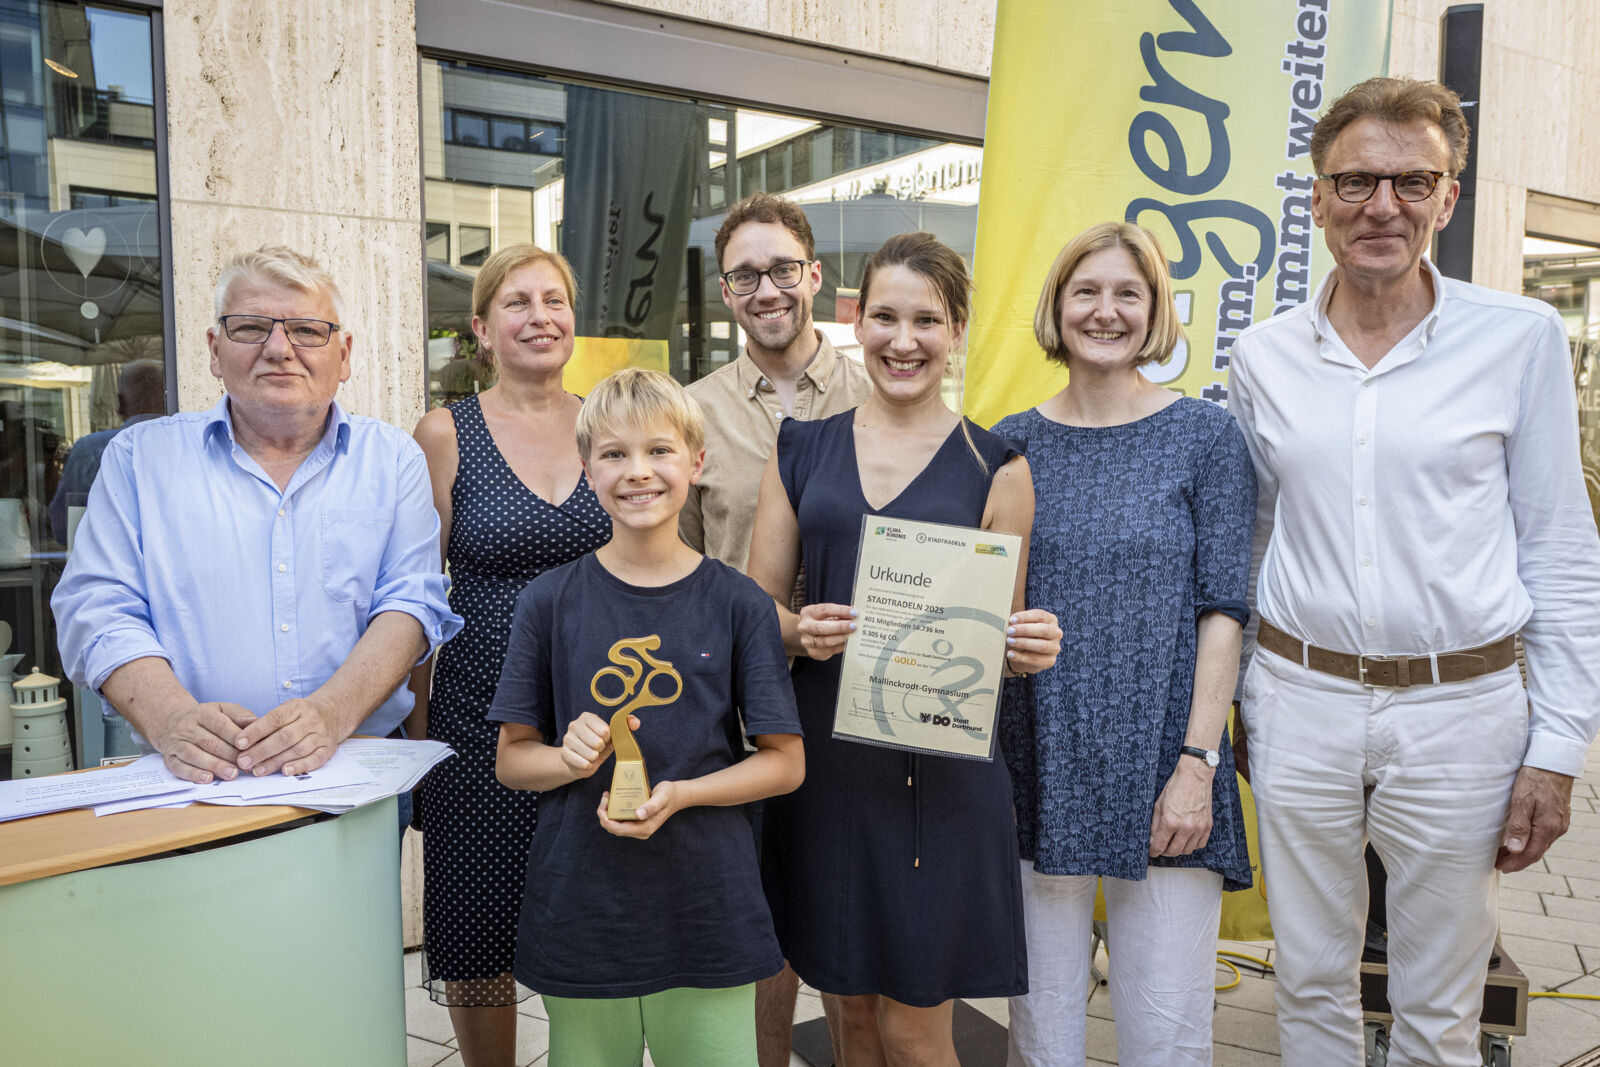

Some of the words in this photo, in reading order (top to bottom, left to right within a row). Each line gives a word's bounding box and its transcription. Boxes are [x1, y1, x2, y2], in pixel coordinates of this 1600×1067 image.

[927, 536, 966, 547] STADTRADELN
[869, 565, 932, 588] Urkunde
[866, 594, 923, 611] STADTRADELN
[924, 604, 944, 614] 2025
[863, 615, 875, 623] 401
[876, 617, 911, 629] Mitgliedern
[861, 629, 878, 638] 9.305
[879, 632, 887, 640] kg
[893, 655, 917, 665] GOLD
[868, 675, 969, 699] Mallinckrodt-Gymnasium
[932, 714, 951, 727] DO
[953, 716, 969, 724] Stadt
[951, 723, 982, 732] Dortmund
